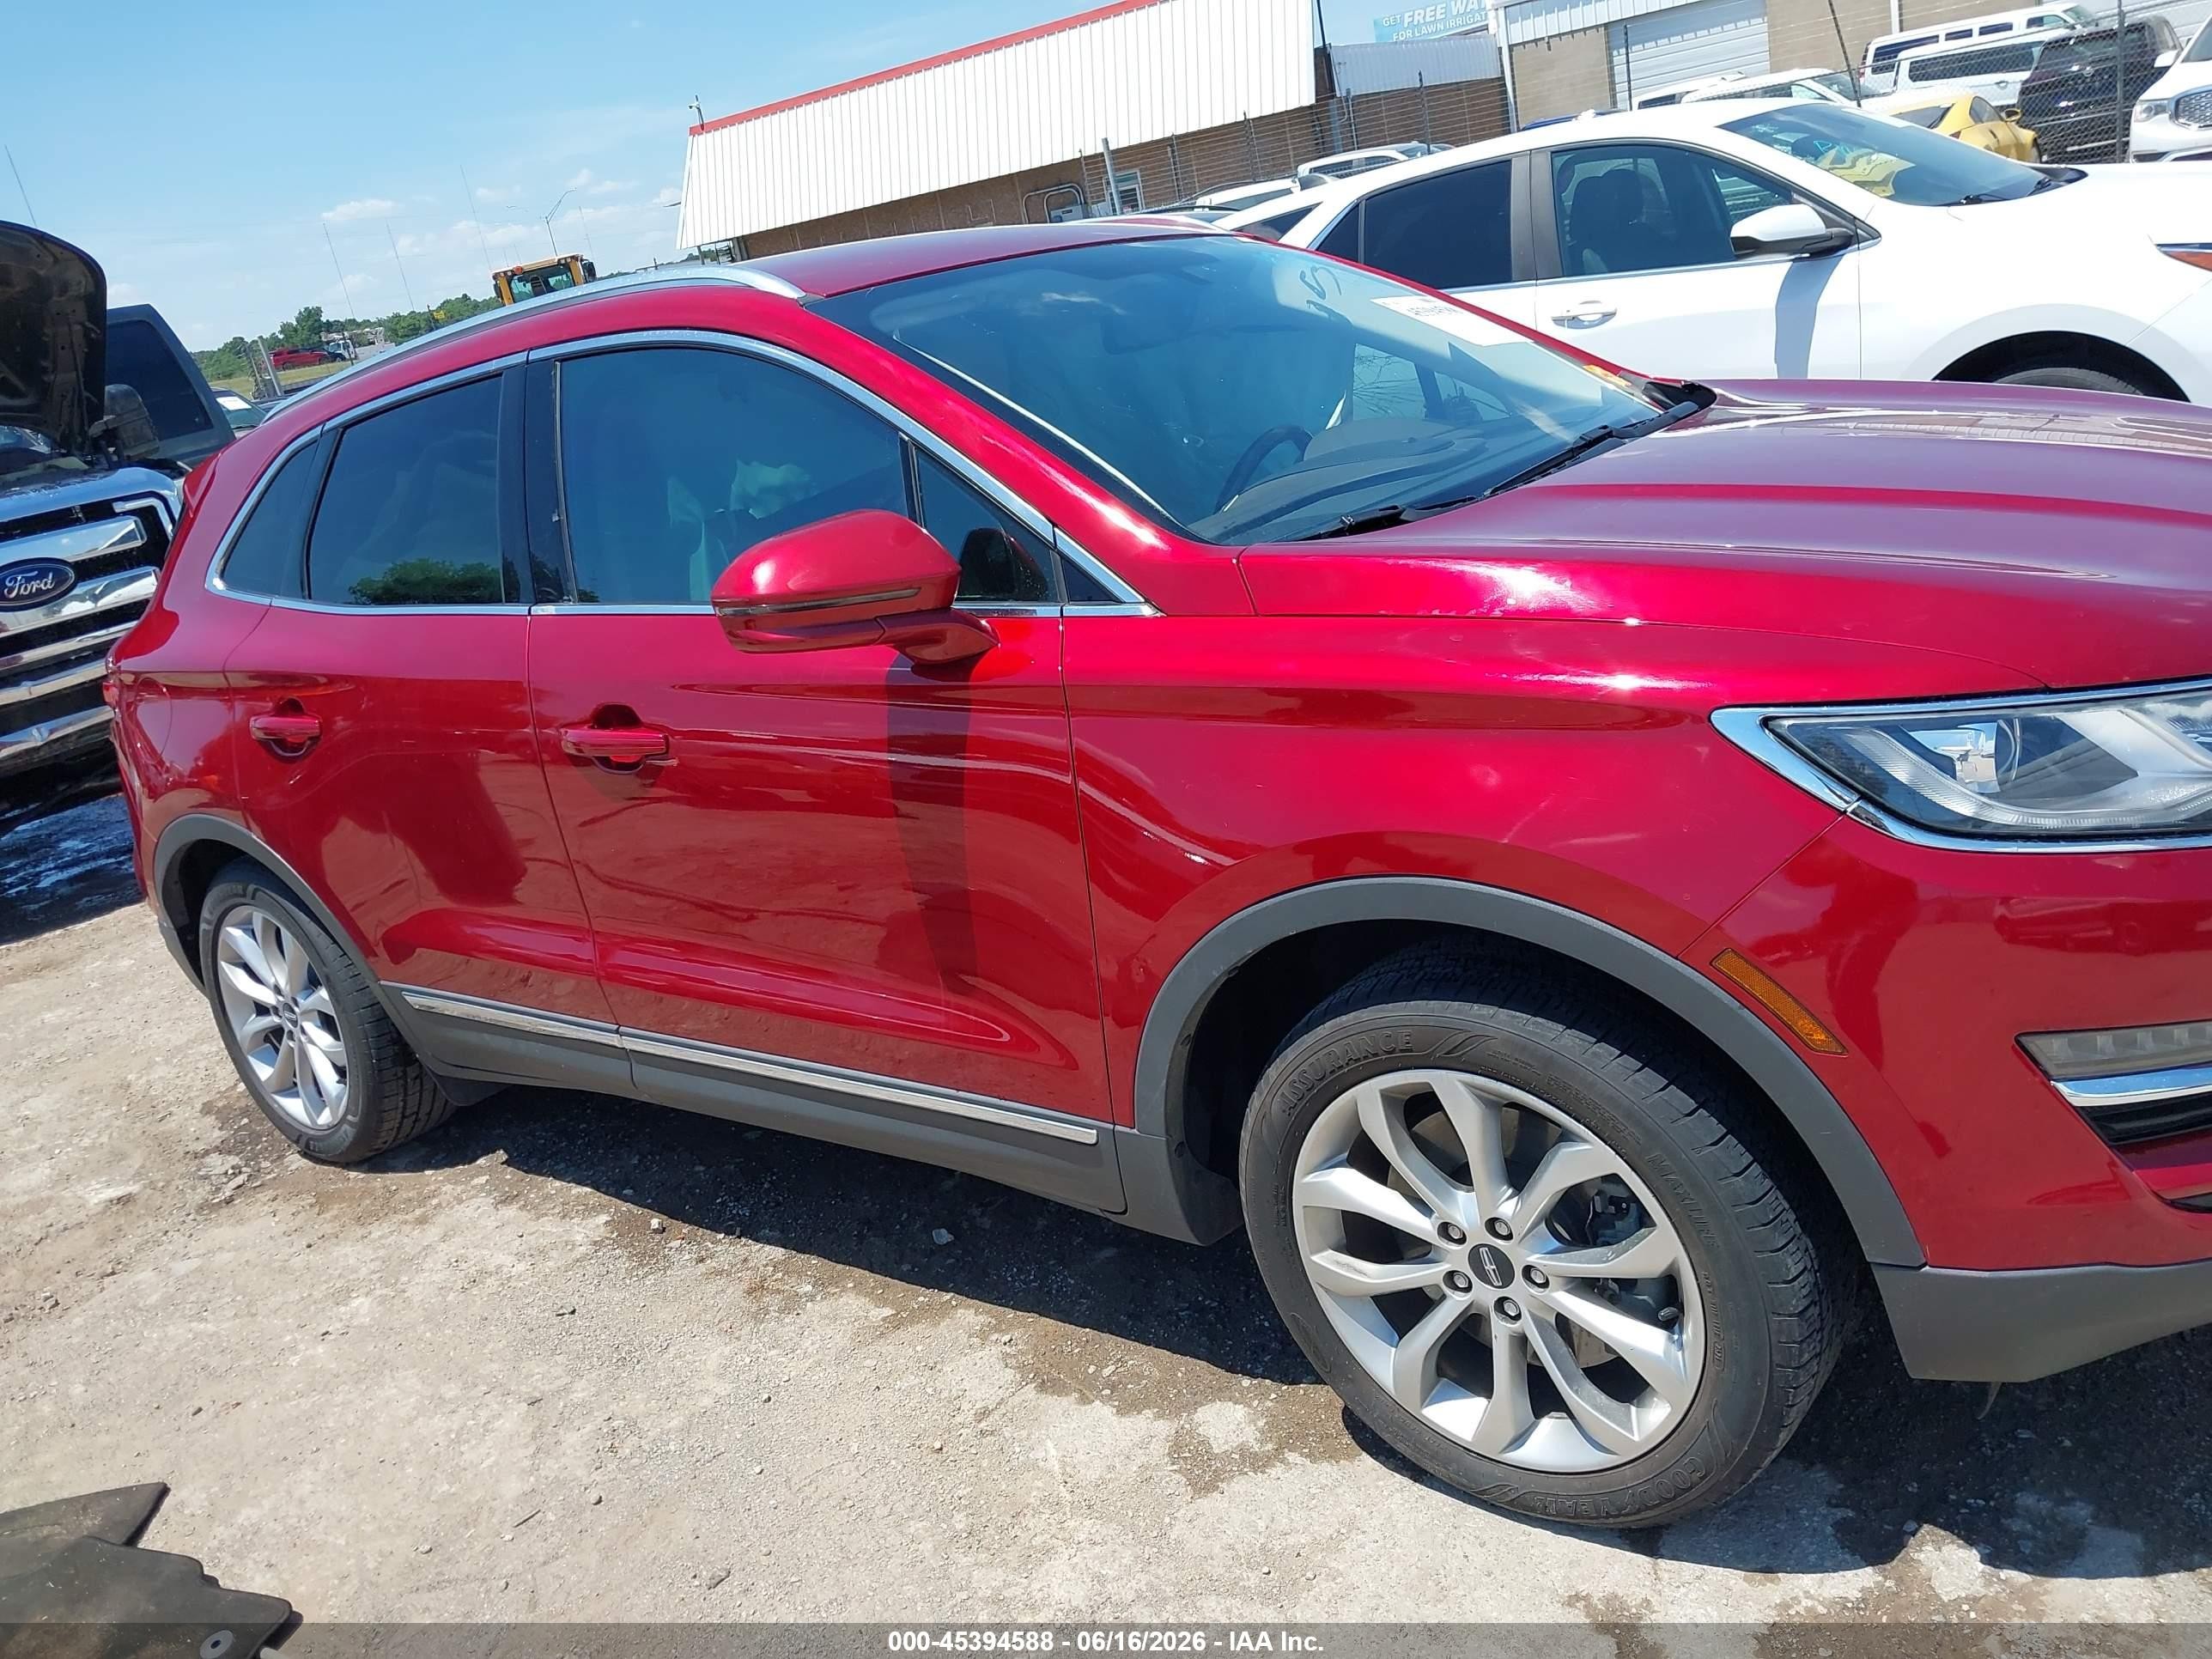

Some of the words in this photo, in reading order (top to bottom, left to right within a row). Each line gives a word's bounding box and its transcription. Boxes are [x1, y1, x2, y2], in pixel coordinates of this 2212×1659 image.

[1382, 15, 1401, 27] GET
[1403, 3, 1447, 27] FREE
[1393, 27, 1413, 42] FOR
[1414, 21, 1445, 37] LAWN
[4, 570, 55, 598] Ford
[1277, 1030, 1415, 1116] ASSURANCE
